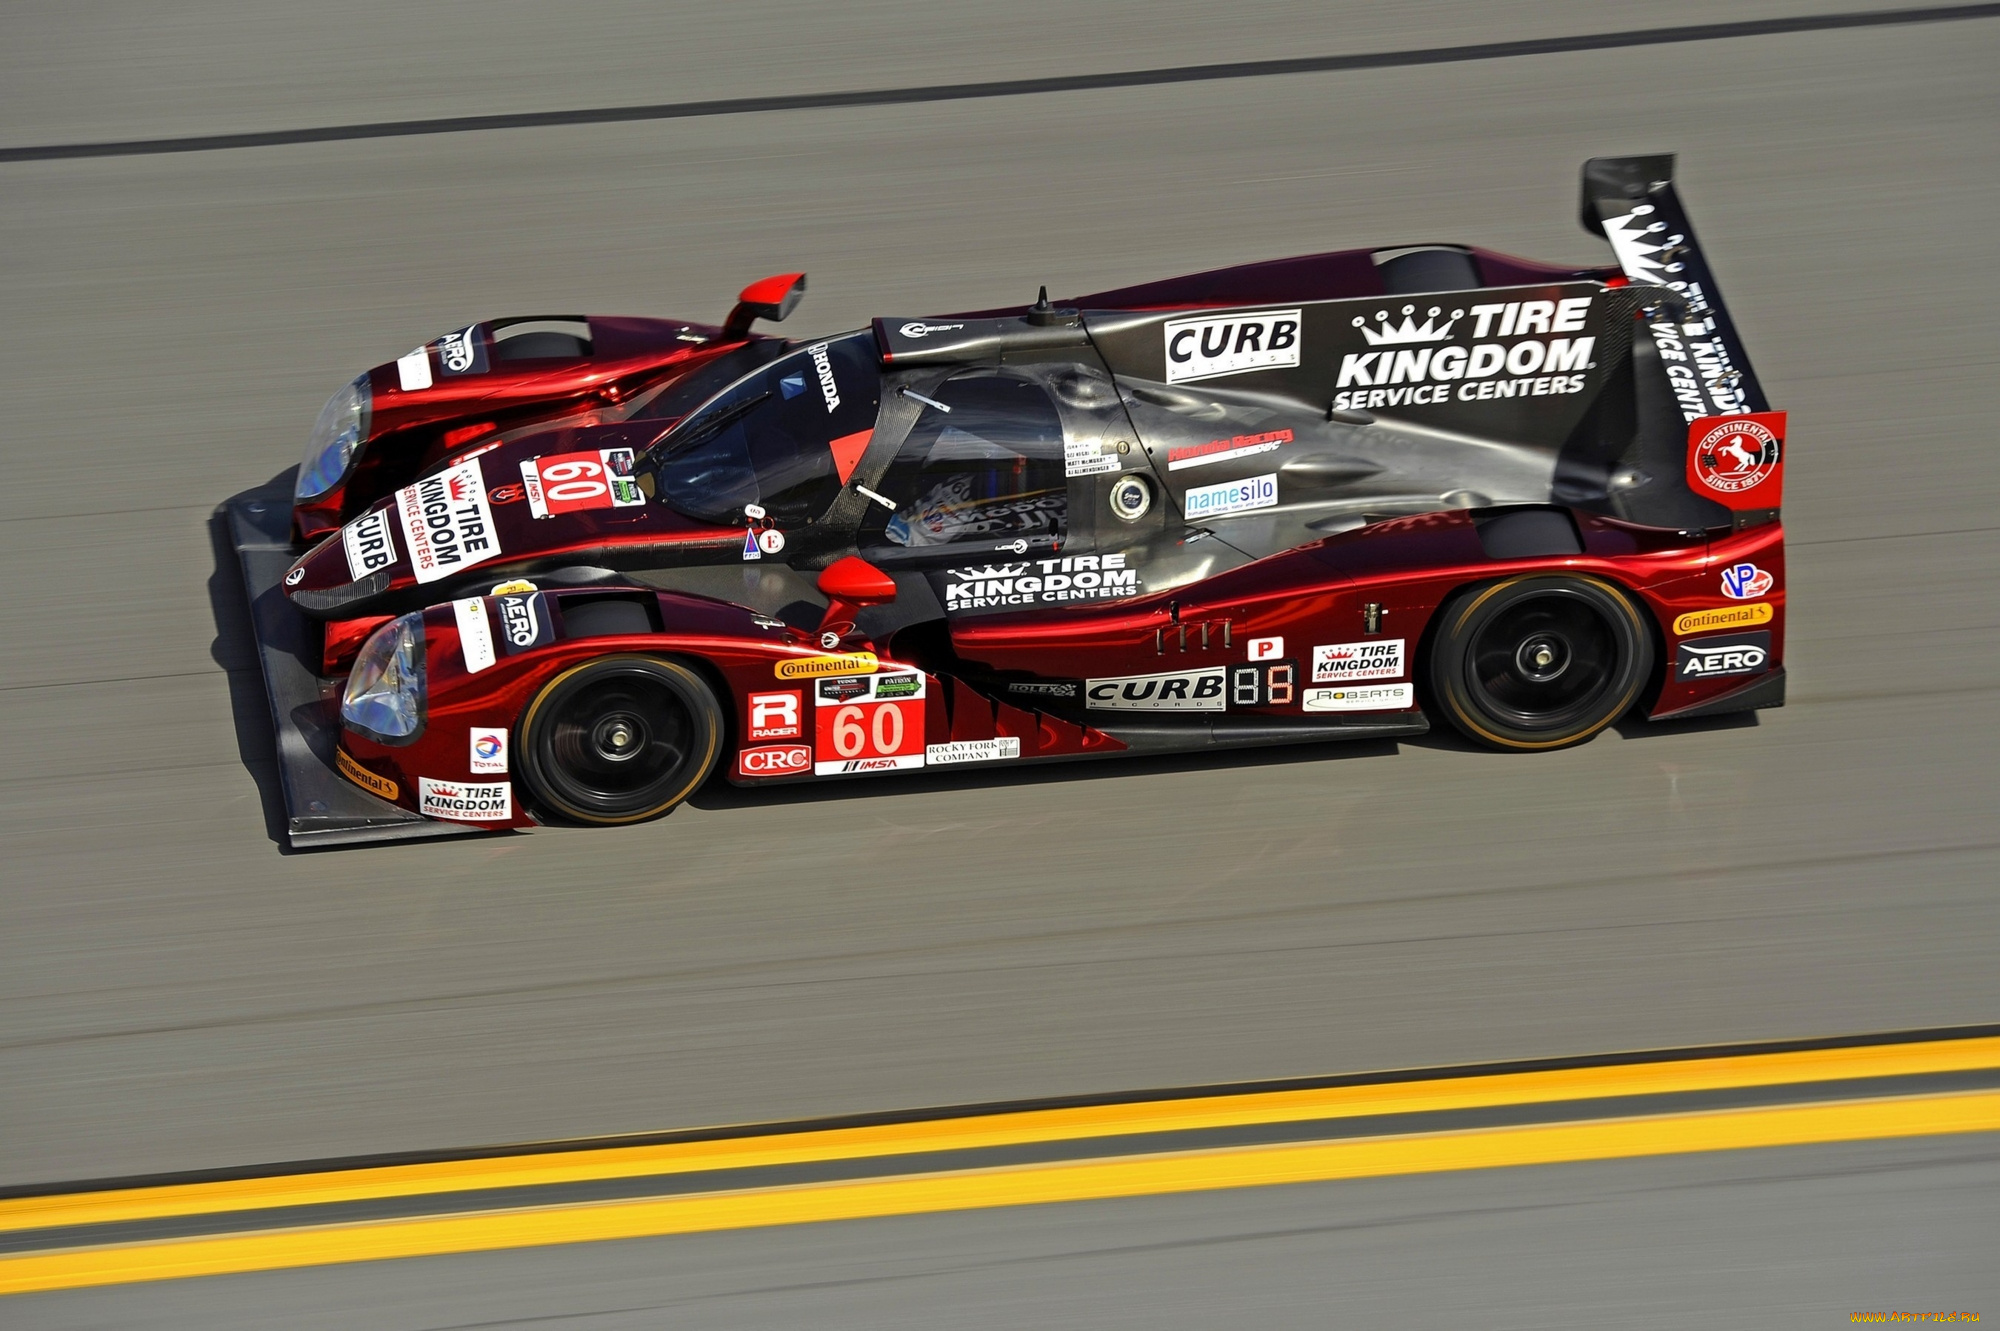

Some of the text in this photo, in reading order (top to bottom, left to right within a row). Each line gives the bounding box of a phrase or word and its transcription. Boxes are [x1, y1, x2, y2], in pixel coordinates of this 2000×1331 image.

[1469, 296, 1592, 339] TIRE
[441, 333, 467, 371] AERO
[1169, 320, 1297, 364] CURB
[1335, 336, 1596, 388] KINGDOM
[813, 351, 841, 414] HONDA
[1332, 374, 1587, 411] SERVICE CENTERS
[1168, 439, 1230, 462] Honda
[1232, 428, 1293, 449] Racing
[1702, 423, 1772, 450] CONTINENTAL
[542, 460, 607, 501] 60
[1705, 471, 1764, 490] SINCE 1871
[1187, 479, 1273, 511] namesilo
[403, 485, 434, 569] SERVICE CENTERS
[419, 477, 461, 565] KINGDOM
[455, 504, 489, 553] TIRE
[355, 515, 388, 569] CURB
[1036, 553, 1127, 574] TIRE
[945, 569, 1139, 601] KINGDOM
[1724, 565, 1754, 597] VP
[946, 586, 1138, 611] SERVICE CENTERS
[504, 597, 533, 647] AERO
[1679, 608, 1754, 632] Continental
[1257, 641, 1274, 657] P
[1360, 644, 1397, 657] TIRE
[781, 657, 861, 677] Continental
[1316, 668, 1397, 680] SERVICE CENTERS
[1317, 657, 1400, 672] KINGDOM
[1682, 650, 1764, 674] AERO
[1009, 684, 1058, 694] ROLEX
[1088, 675, 1224, 700] CURB
[1316, 688, 1404, 700] ROBERTS
[752, 728, 798, 738] RACER
[832, 702, 904, 758] 60
[928, 741, 998, 754] ROCKY FORK
[936, 751, 991, 763] COMPANY
[472, 760, 504, 768] TOTAL
[743, 748, 808, 772] CRC
[859, 759, 898, 770] IMSA
[424, 795, 506, 810] KINGDOM
[464, 787, 504, 798] TIRE
[423, 805, 460, 817] SERVICE
